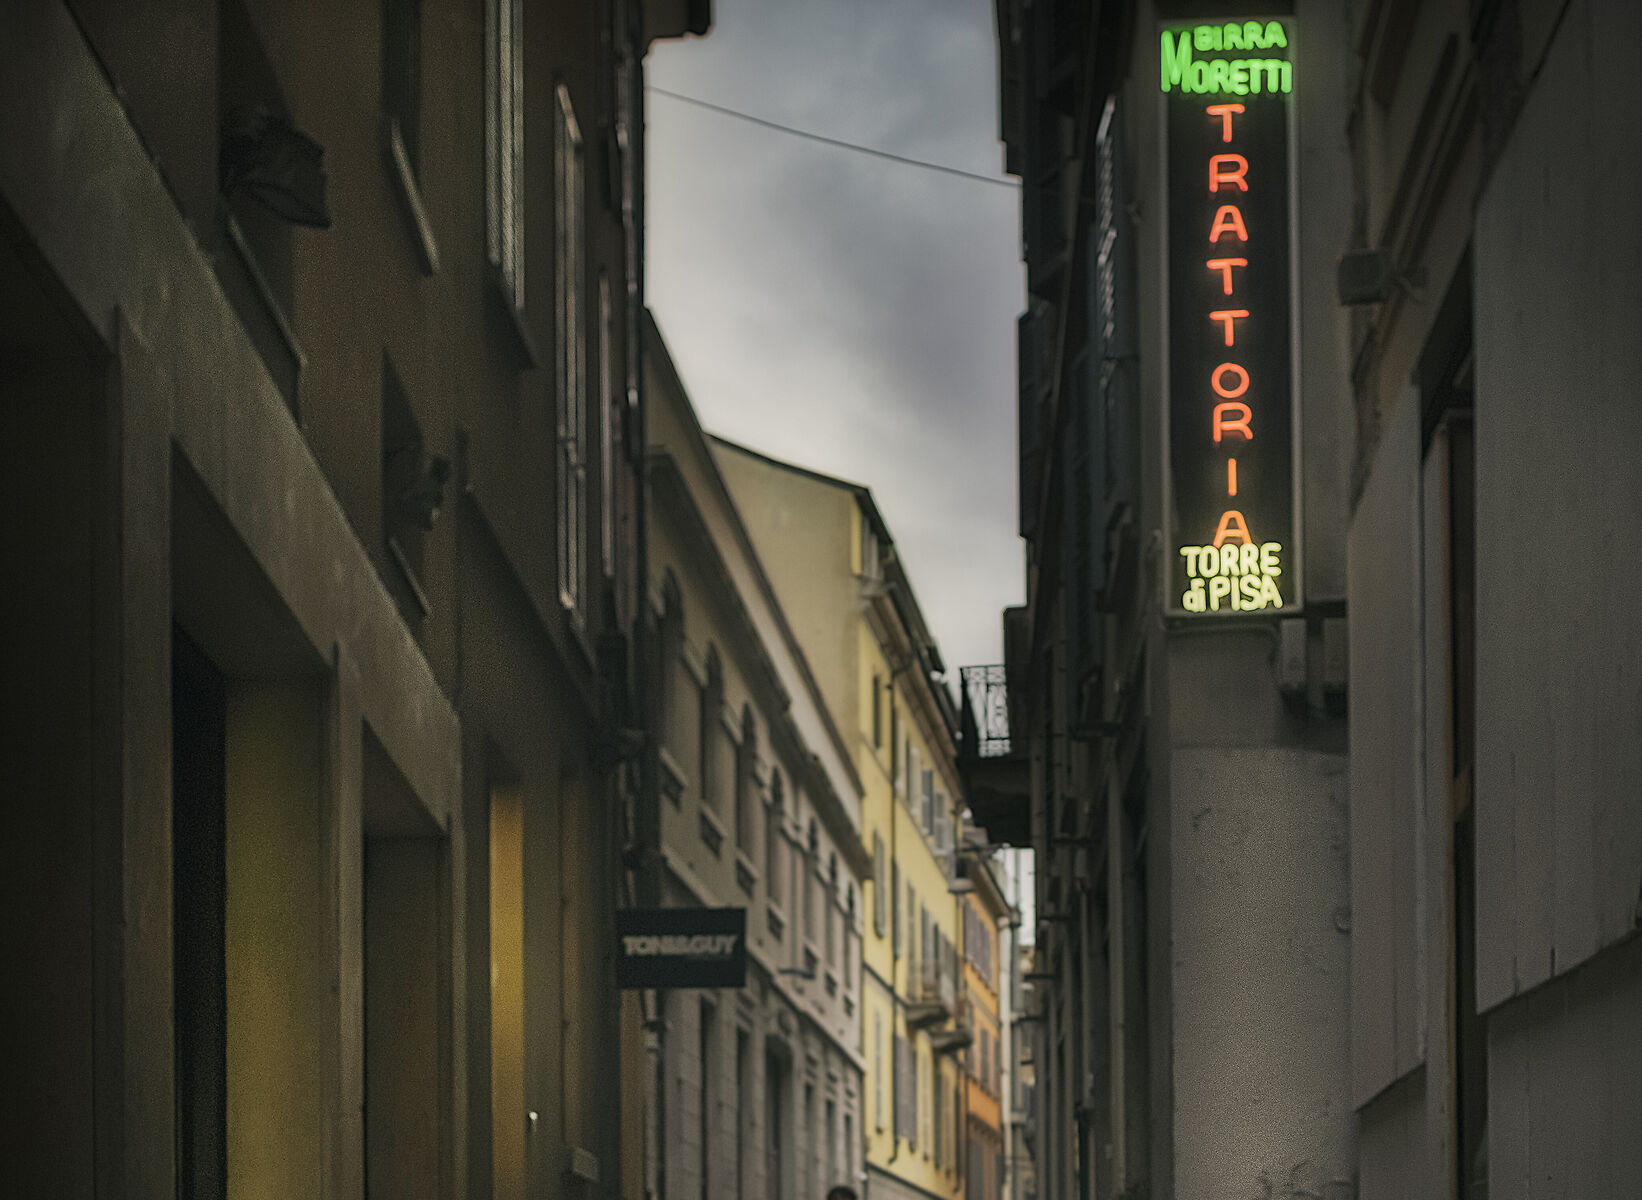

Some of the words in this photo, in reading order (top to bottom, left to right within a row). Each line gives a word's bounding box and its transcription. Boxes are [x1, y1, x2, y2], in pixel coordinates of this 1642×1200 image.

[1194, 21, 1287, 51] BIRRA
[1160, 30, 1292, 95] MORETTI
[1205, 103, 1253, 548] TRATTORIA
[1179, 542, 1282, 577] TORRE
[1182, 578, 1206, 612] di
[1209, 574, 1283, 611] PISA
